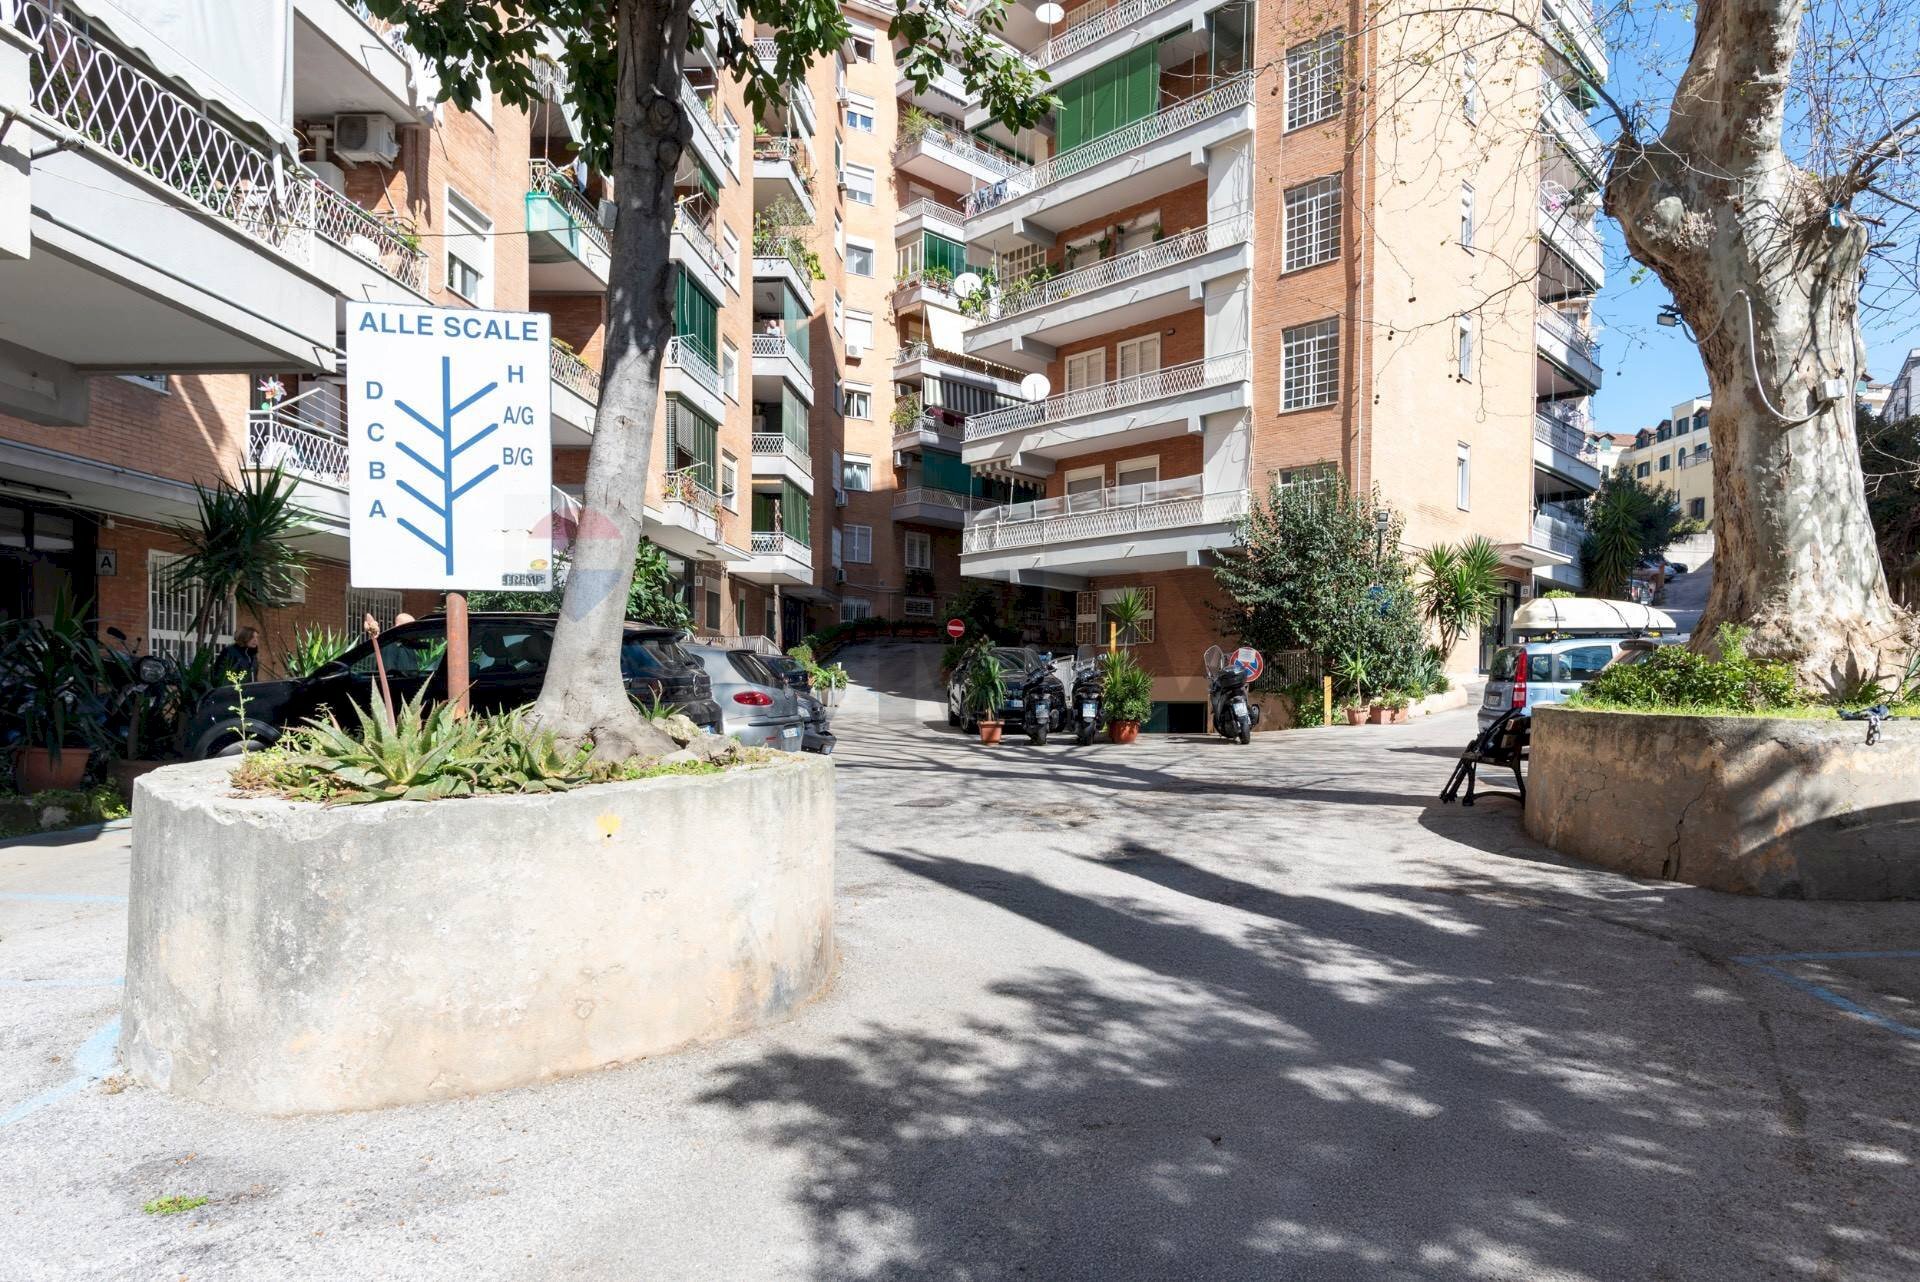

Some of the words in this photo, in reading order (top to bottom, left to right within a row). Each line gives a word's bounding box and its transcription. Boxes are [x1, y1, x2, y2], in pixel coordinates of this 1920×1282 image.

[359, 312, 433, 335] ALLE
[444, 317, 538, 341] SCALE
[508, 365, 523, 383] H
[367, 381, 383, 399] D
[504, 406, 533, 425] A/G
[368, 423, 384, 442] C
[503, 448, 532, 466] B/G
[369, 462, 385, 479] B
[369, 500, 386, 518] A
[101, 556, 112, 568] A
